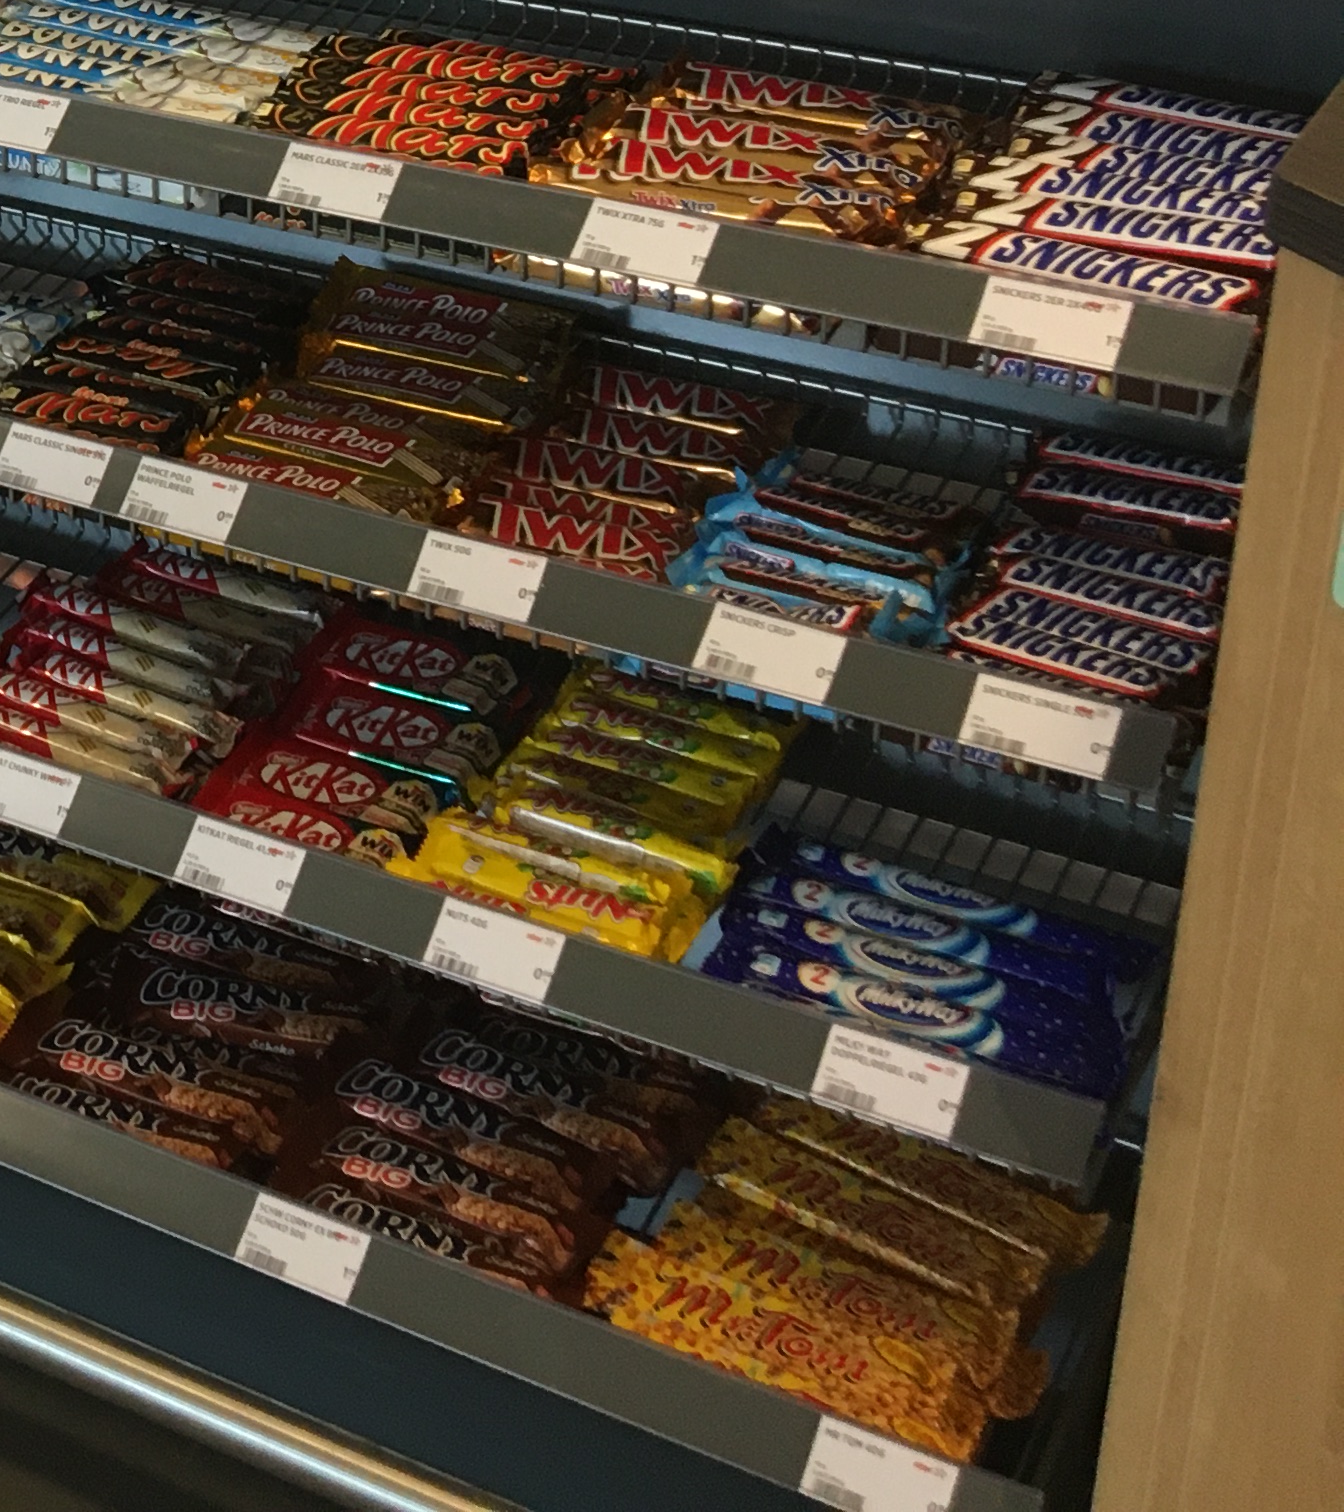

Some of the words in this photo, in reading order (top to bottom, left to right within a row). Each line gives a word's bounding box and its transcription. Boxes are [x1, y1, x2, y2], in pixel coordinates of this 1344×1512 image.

[365, 43, 581, 87] Mars
[308, 113, 527, 165] Mars
[992, 233, 1249, 306] SNICKERS
[13, 390, 177, 433] Mars
[249, 411, 333, 445] PRINCE
[335, 423, 395, 456] POLO
[141, 464, 170, 479] PRINCE
[172, 471, 193, 484] POLO
[284, 464, 342, 494] POLO
[992, 591, 1200, 672] SNICKERS
[344, 632, 458, 680] KitKat
[259, 754, 379, 806] KitKat
[38, 1019, 204, 1086] CORNY
[59, 1050, 126, 1082] BIG
[341, 1155, 412, 1188] BIG
